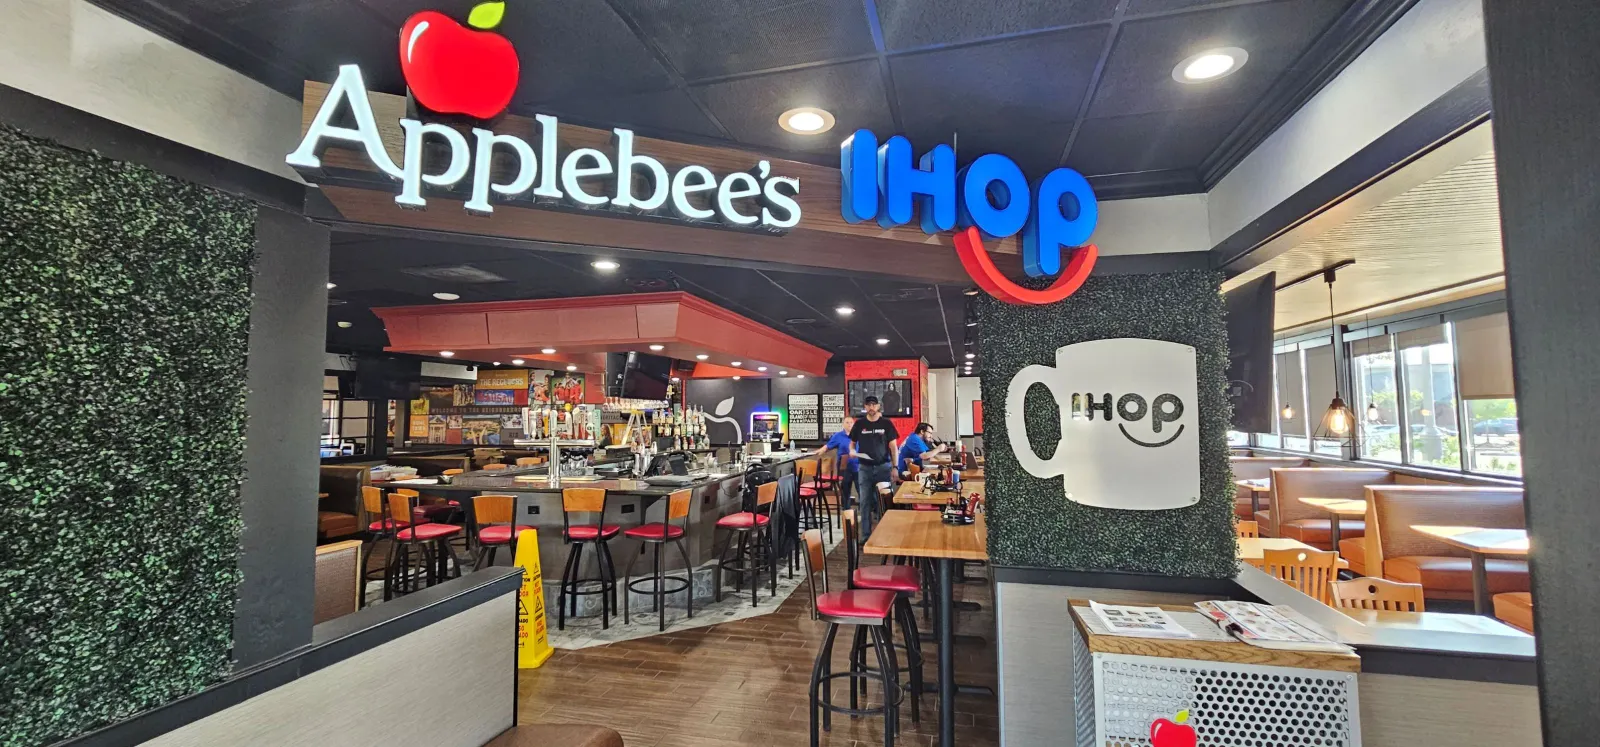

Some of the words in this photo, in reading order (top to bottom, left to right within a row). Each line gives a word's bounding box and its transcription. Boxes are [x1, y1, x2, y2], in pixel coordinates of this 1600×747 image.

[285, 63, 802, 228] Applebee's
[842, 129, 1098, 277] IHOP
[480, 378, 492, 386] THE
[1071, 392, 1184, 434] IHOP
